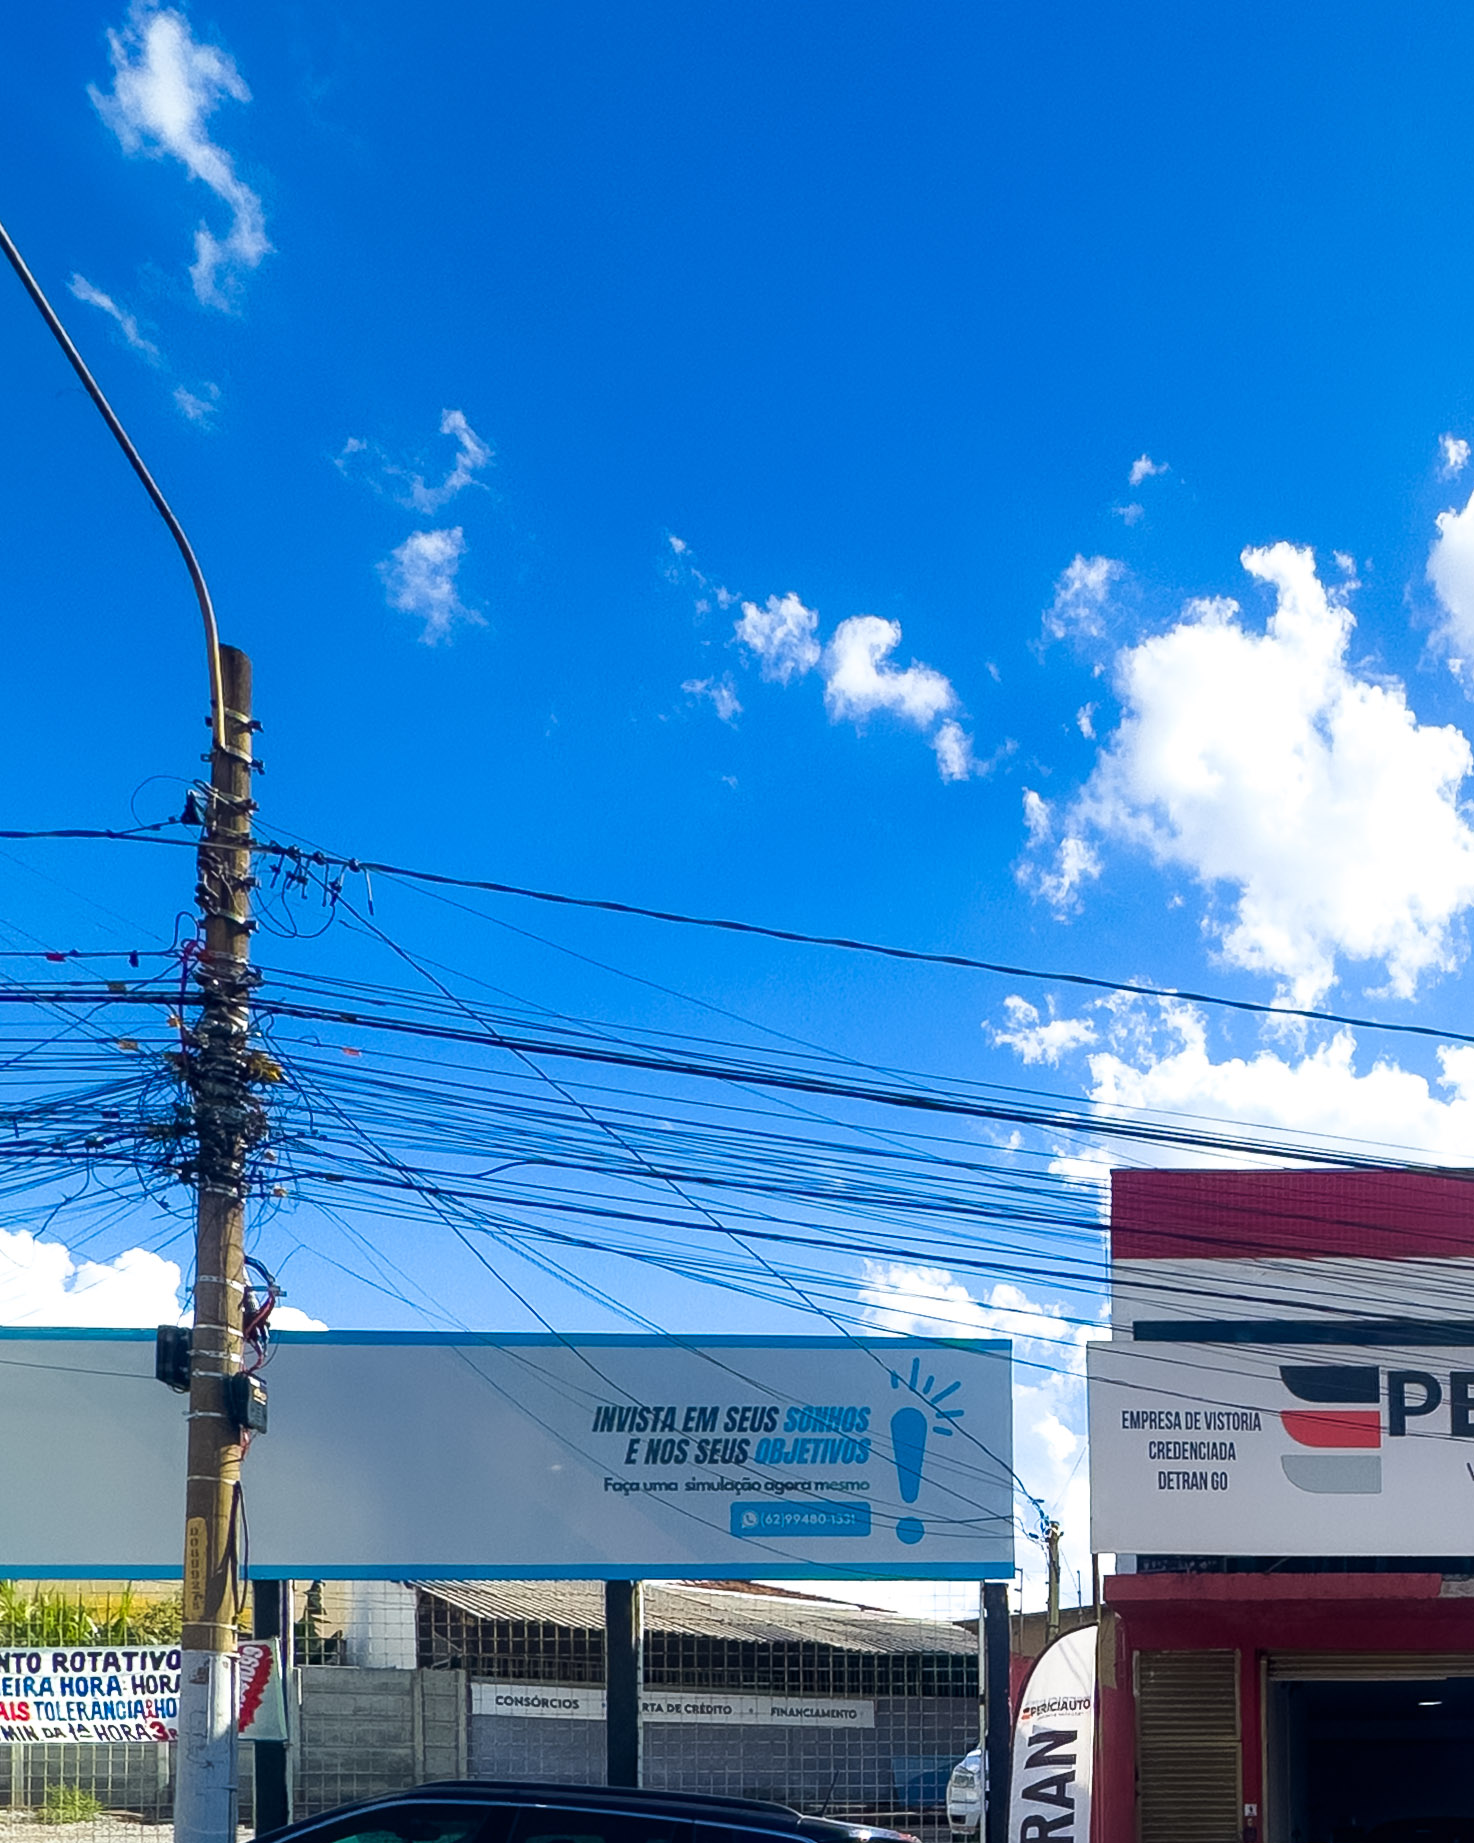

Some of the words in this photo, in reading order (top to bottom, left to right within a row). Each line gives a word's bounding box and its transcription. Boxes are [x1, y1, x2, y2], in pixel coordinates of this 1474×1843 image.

[592, 1406, 677, 1433] INVISTA
[682, 1406, 721, 1433] EM
[723, 1405, 780, 1433] SEUS
[783, 1406, 872, 1433] SONHOS
[1121, 1410, 1182, 1430] EMPRESA
[1185, 1411, 1201, 1430] DE
[1204, 1411, 1262, 1431] VISTORIA
[624, 1438, 641, 1465] E
[644, 1438, 690, 1465] NOS
[694, 1438, 751, 1465] SEUS
[754, 1438, 872, 1465] OBJETIVOS
[1149, 1440, 1237, 1460] CREDENCIADA
[604, 1477, 640, 1496] Faça
[643, 1481, 678, 1492] uma
[684, 1477, 761, 1496] simulação
[764, 1480, 812, 1495] agora
[815, 1480, 870, 1492] mesmo
[1158, 1471, 1208, 1490] DETRAN
[1210, 1471, 1228, 1491] GO
[52, 1649, 181, 1674] ROTATIVO
[494, 1695, 580, 1710] CONSÓRCIOS
[667, 1703, 682, 1715] DE
[684, 1701, 733, 1715] CRÉDITO
[1030, 1698, 1091, 1717] PERICIAUTO
[770, 1706, 858, 1720] FINANCIAMENTO
[93, 1723, 153, 1742] HORA
